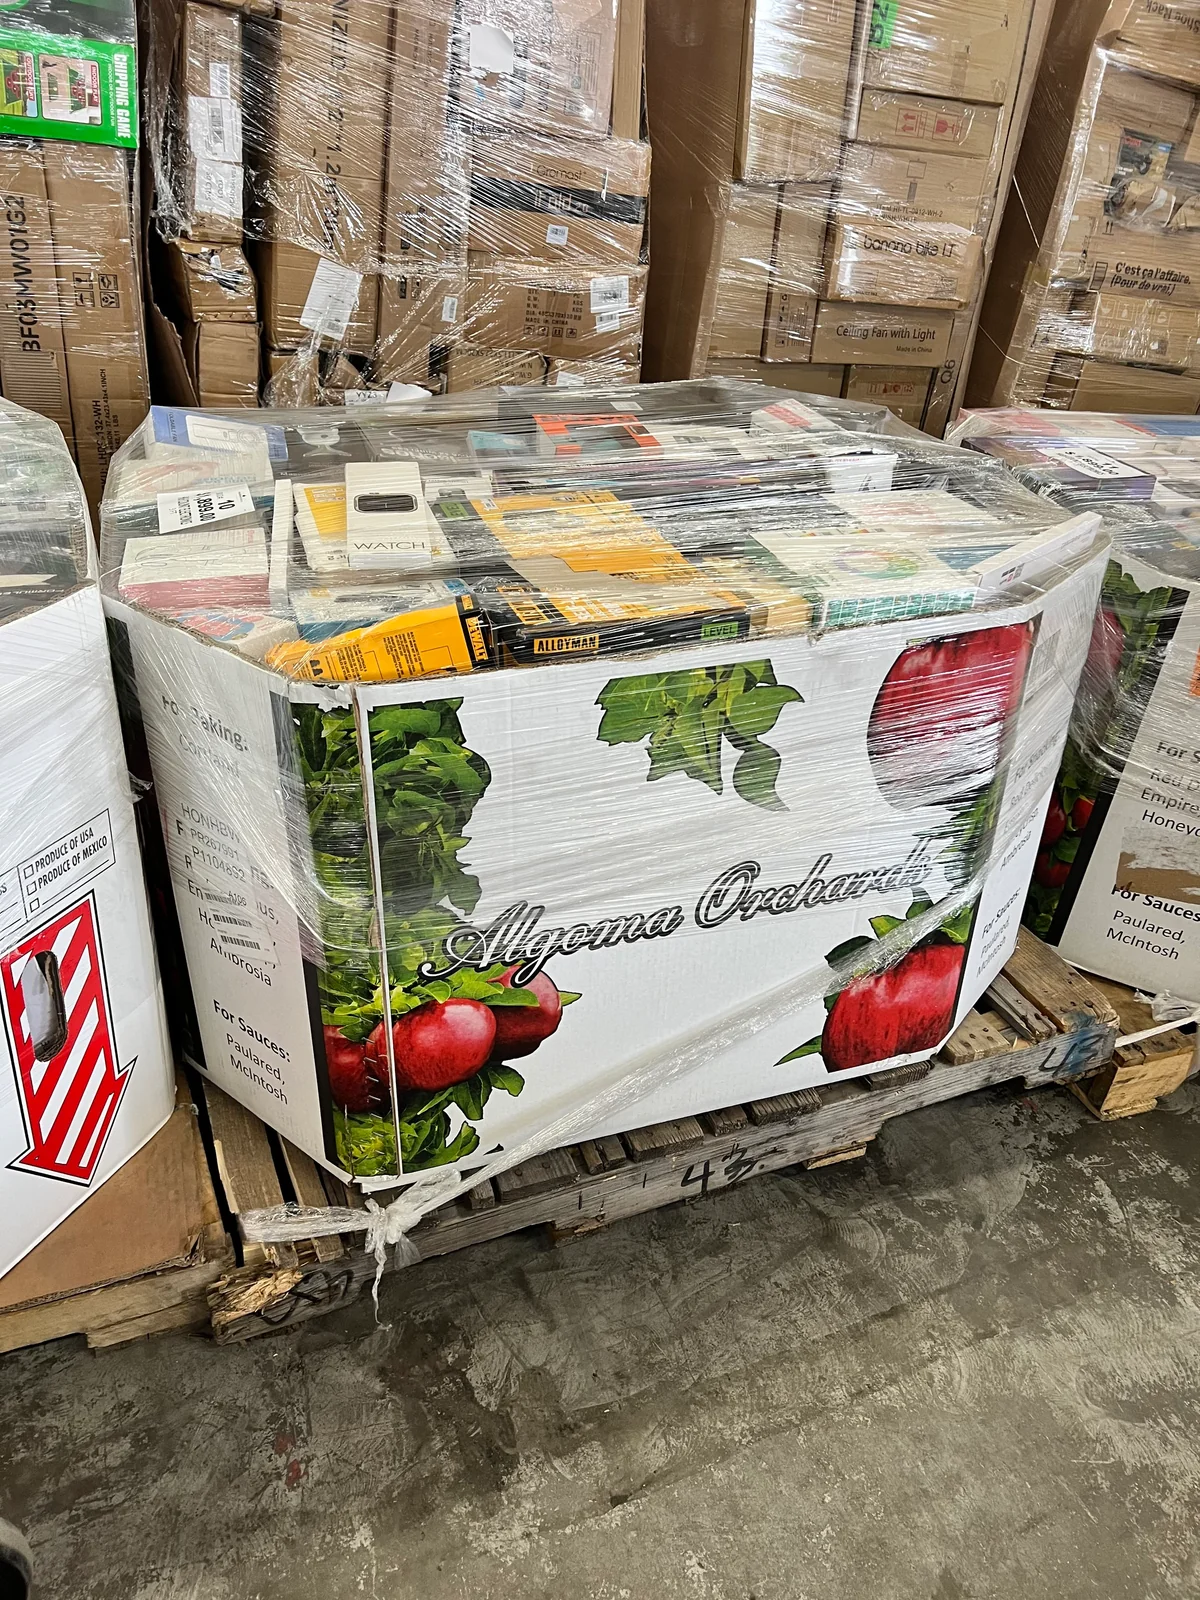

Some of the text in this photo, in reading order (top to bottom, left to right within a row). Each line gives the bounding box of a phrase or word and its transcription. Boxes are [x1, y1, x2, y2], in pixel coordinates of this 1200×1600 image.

[1175, 14, 1200, 33] Shoe
[91, 66, 100, 102] INDOOR PLAY
[113, 53, 131, 140] CHIPPING GAME
[6, 195, 41, 352] BF03MW01G2
[1110, 274, 1138, 288] (Pour
[1138, 280, 1151, 290] de
[1115, 262, 1191, 285] C'est ça l'affaire.
[836, 325, 936, 342] Ceiling Fan with Light
[940, 359, 955, 384] Q6
[217, 499, 236, 510] 10
[353, 541, 426, 551] WATCH
[466, 617, 488, 661] DEWALT
[537, 635, 597, 652] ALLOYMAN
[703, 624, 735, 638] LEVEL
[1156, 741, 1187, 760] For
[35, 827, 94, 873] PRODUCE OF USA
[37, 861, 71, 890] PRODUCE
[71, 853, 81, 867] OF
[82, 835, 108, 862] MEXICO
[694, 837, 934, 929] Orchards
[1111, 884, 1140, 902] For
[1106, 927, 1179, 960] McIntosh
[1113, 910, 1185, 944] Paulared,
[417, 900, 685, 988] Algoma
[213, 999, 291, 1062] For Sauces:
[226, 1032, 286, 1085] Paulared,
[230, 1054, 288, 1105] McIntosh
